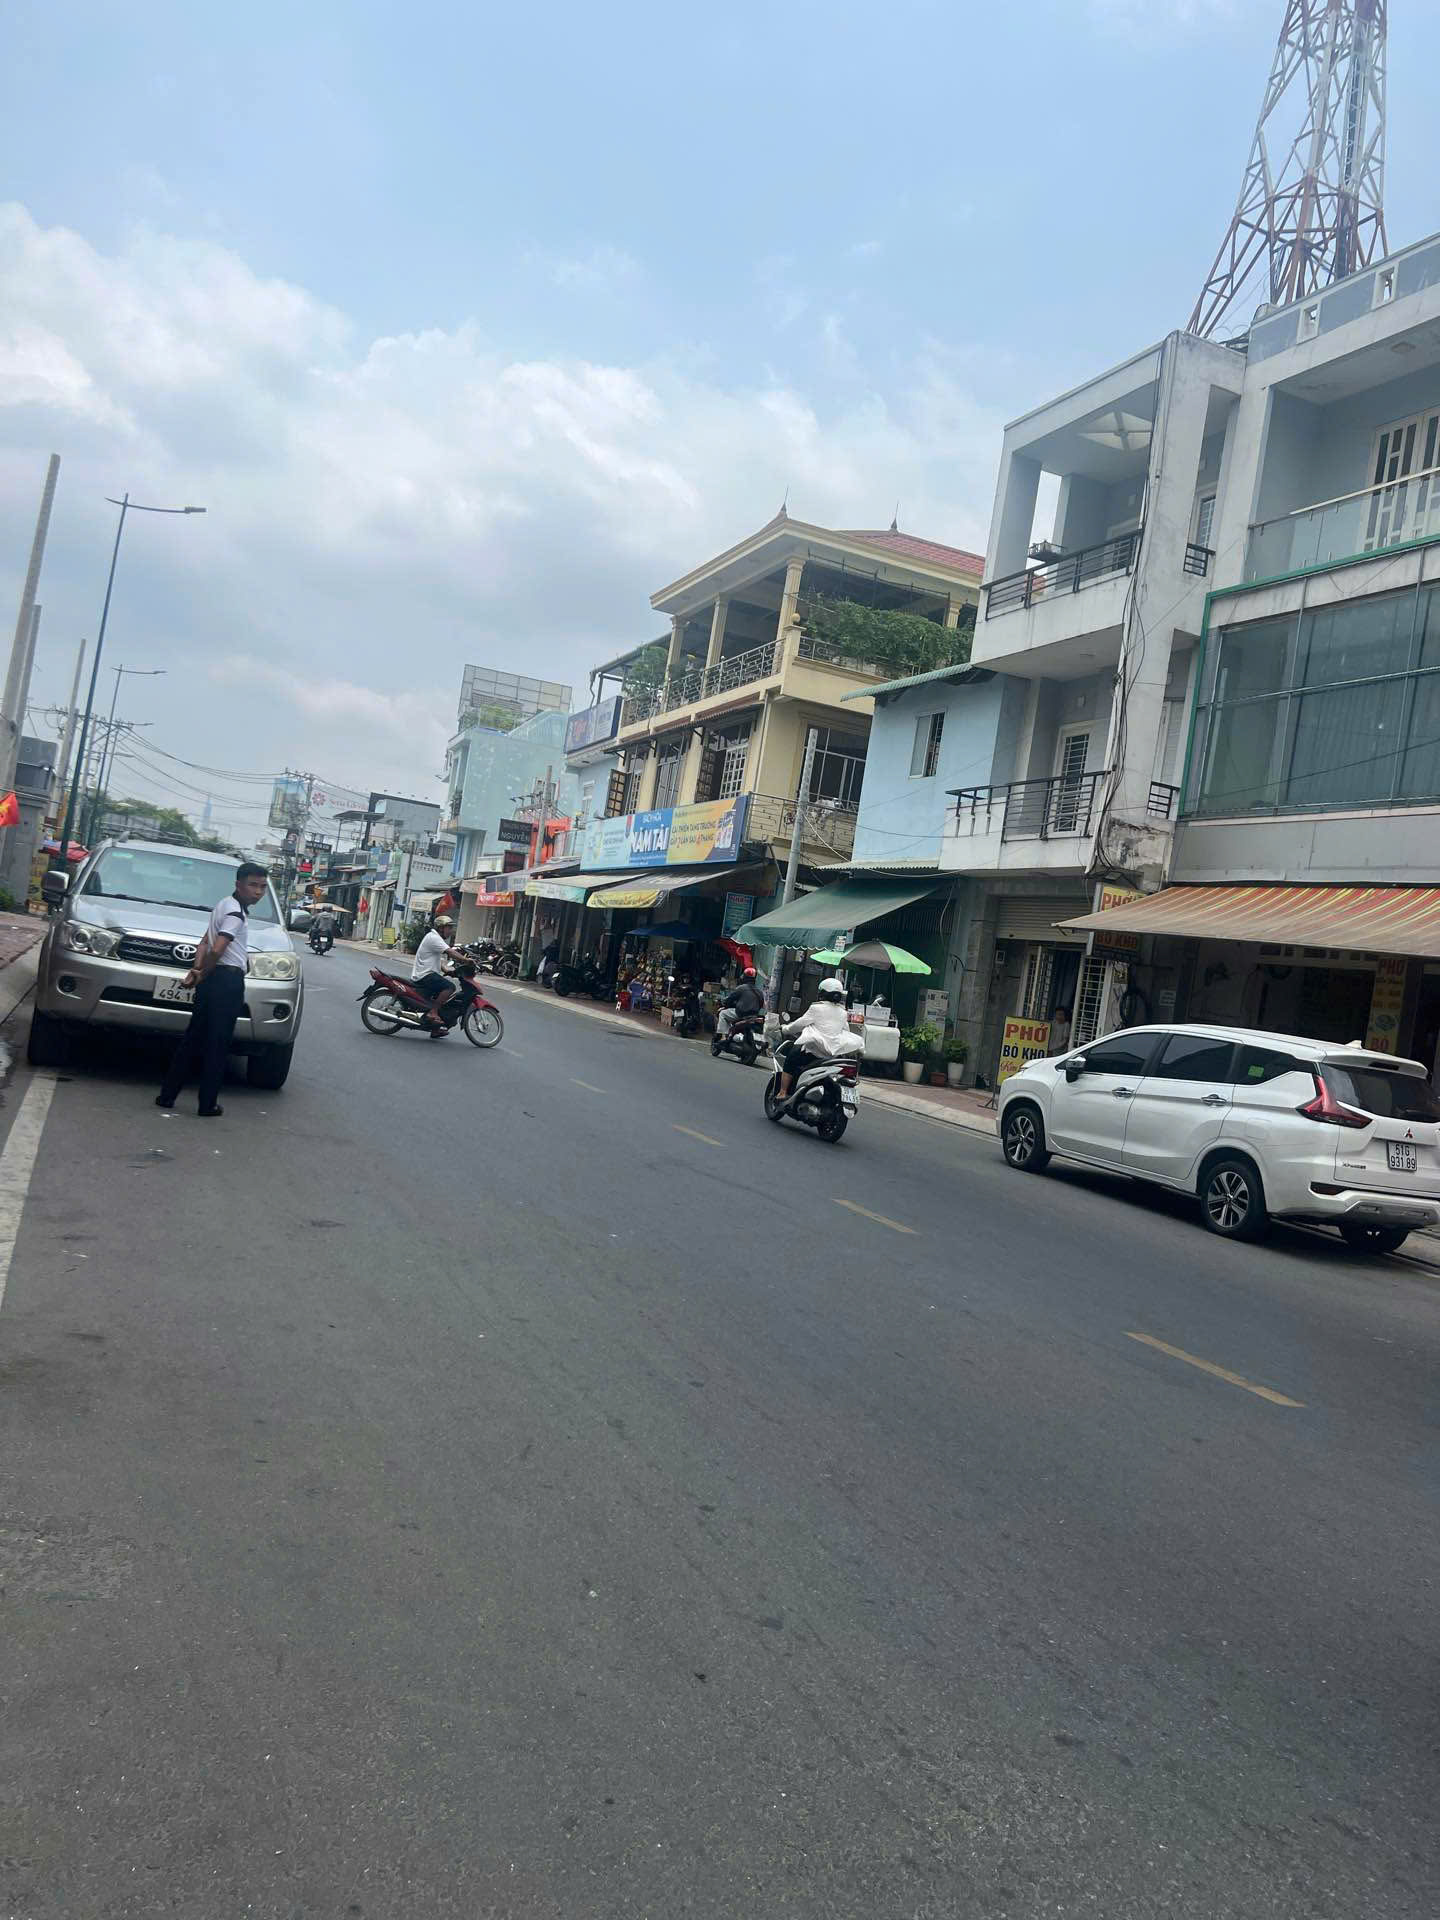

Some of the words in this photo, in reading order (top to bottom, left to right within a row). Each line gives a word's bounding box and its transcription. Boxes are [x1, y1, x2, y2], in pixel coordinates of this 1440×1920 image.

[1005, 1022, 1048, 1043] PHỞ
[1002, 1042, 1018, 1058] BÒ
[1022, 1047, 1045, 1060] KHO
[1395, 1144, 1410, 1157] 51G
